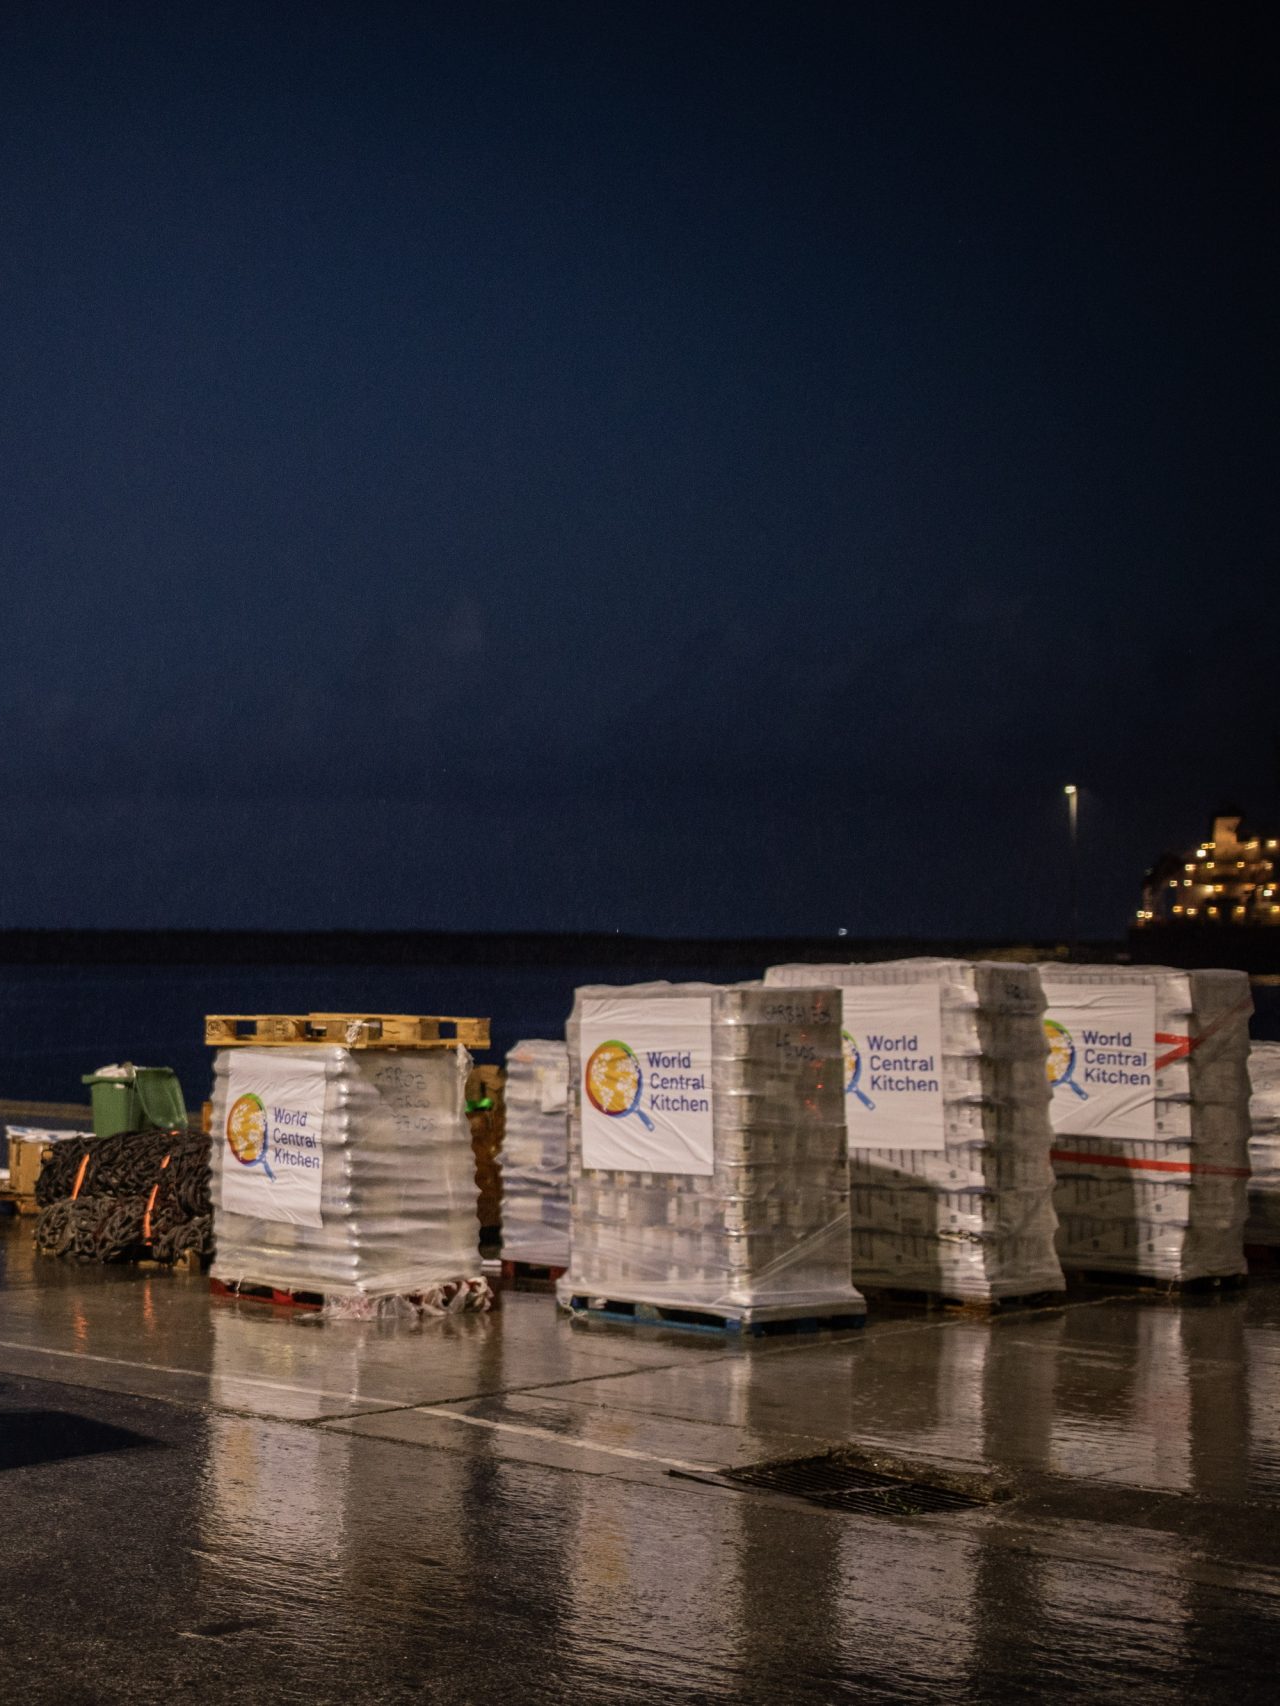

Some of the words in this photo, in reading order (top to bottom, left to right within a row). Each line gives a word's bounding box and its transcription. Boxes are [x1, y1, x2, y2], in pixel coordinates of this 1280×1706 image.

[867, 1035, 918, 1051] World
[1082, 1030, 1132, 1047] World
[646, 1051, 692, 1069] World
[870, 1055, 934, 1071] Central
[1084, 1048, 1147, 1067] Central
[650, 1072, 705, 1090] Central
[871, 1075, 939, 1092] Kitchen
[1085, 1067, 1151, 1086] Kitchen
[650, 1094, 709, 1112] Kitchen
[274, 1107, 308, 1127] World
[273, 1128, 317, 1148] Central
[274, 1147, 320, 1169] Kitchen
